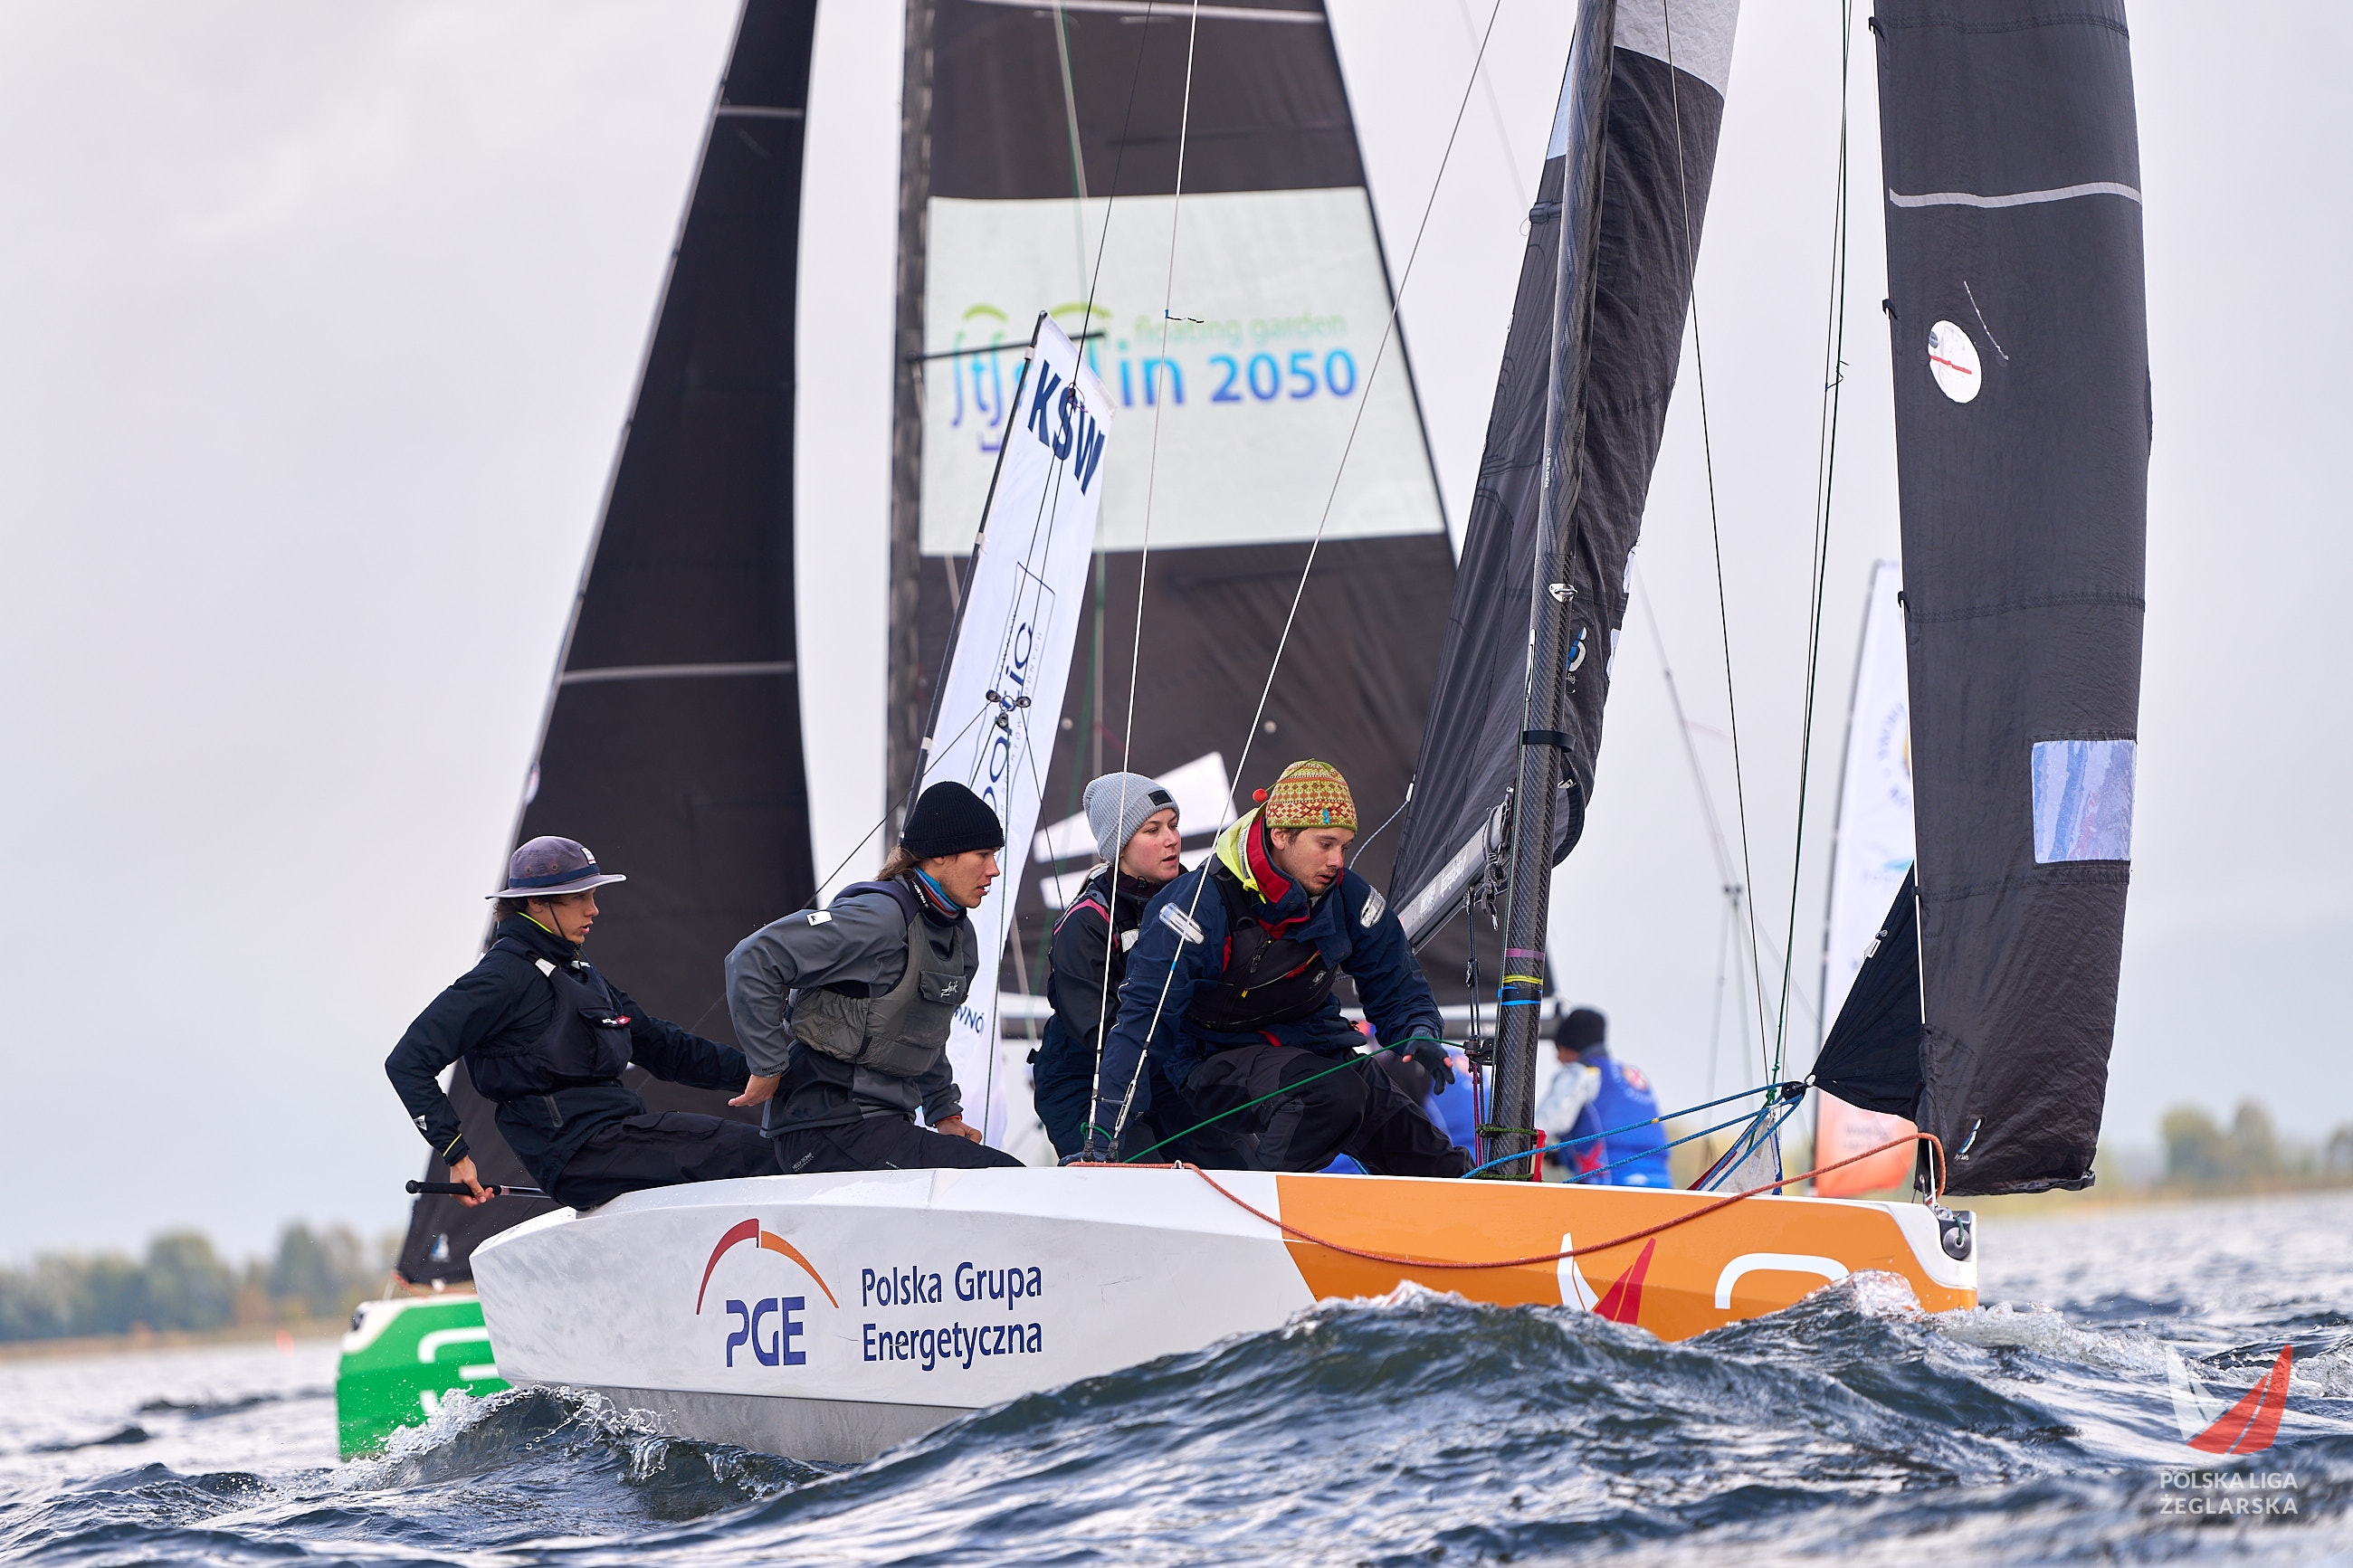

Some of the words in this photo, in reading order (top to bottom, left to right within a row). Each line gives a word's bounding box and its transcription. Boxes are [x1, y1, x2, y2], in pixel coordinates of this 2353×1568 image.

[1248, 309, 1348, 346] garden
[1207, 347, 1358, 403] 2050
[1028, 359, 1106, 497] KSW
[862, 1265, 942, 1307] Polska
[954, 1261, 1043, 1311] Grupa
[725, 1296, 806, 1368] PGE
[862, 1321, 1043, 1372] Energetyczna
